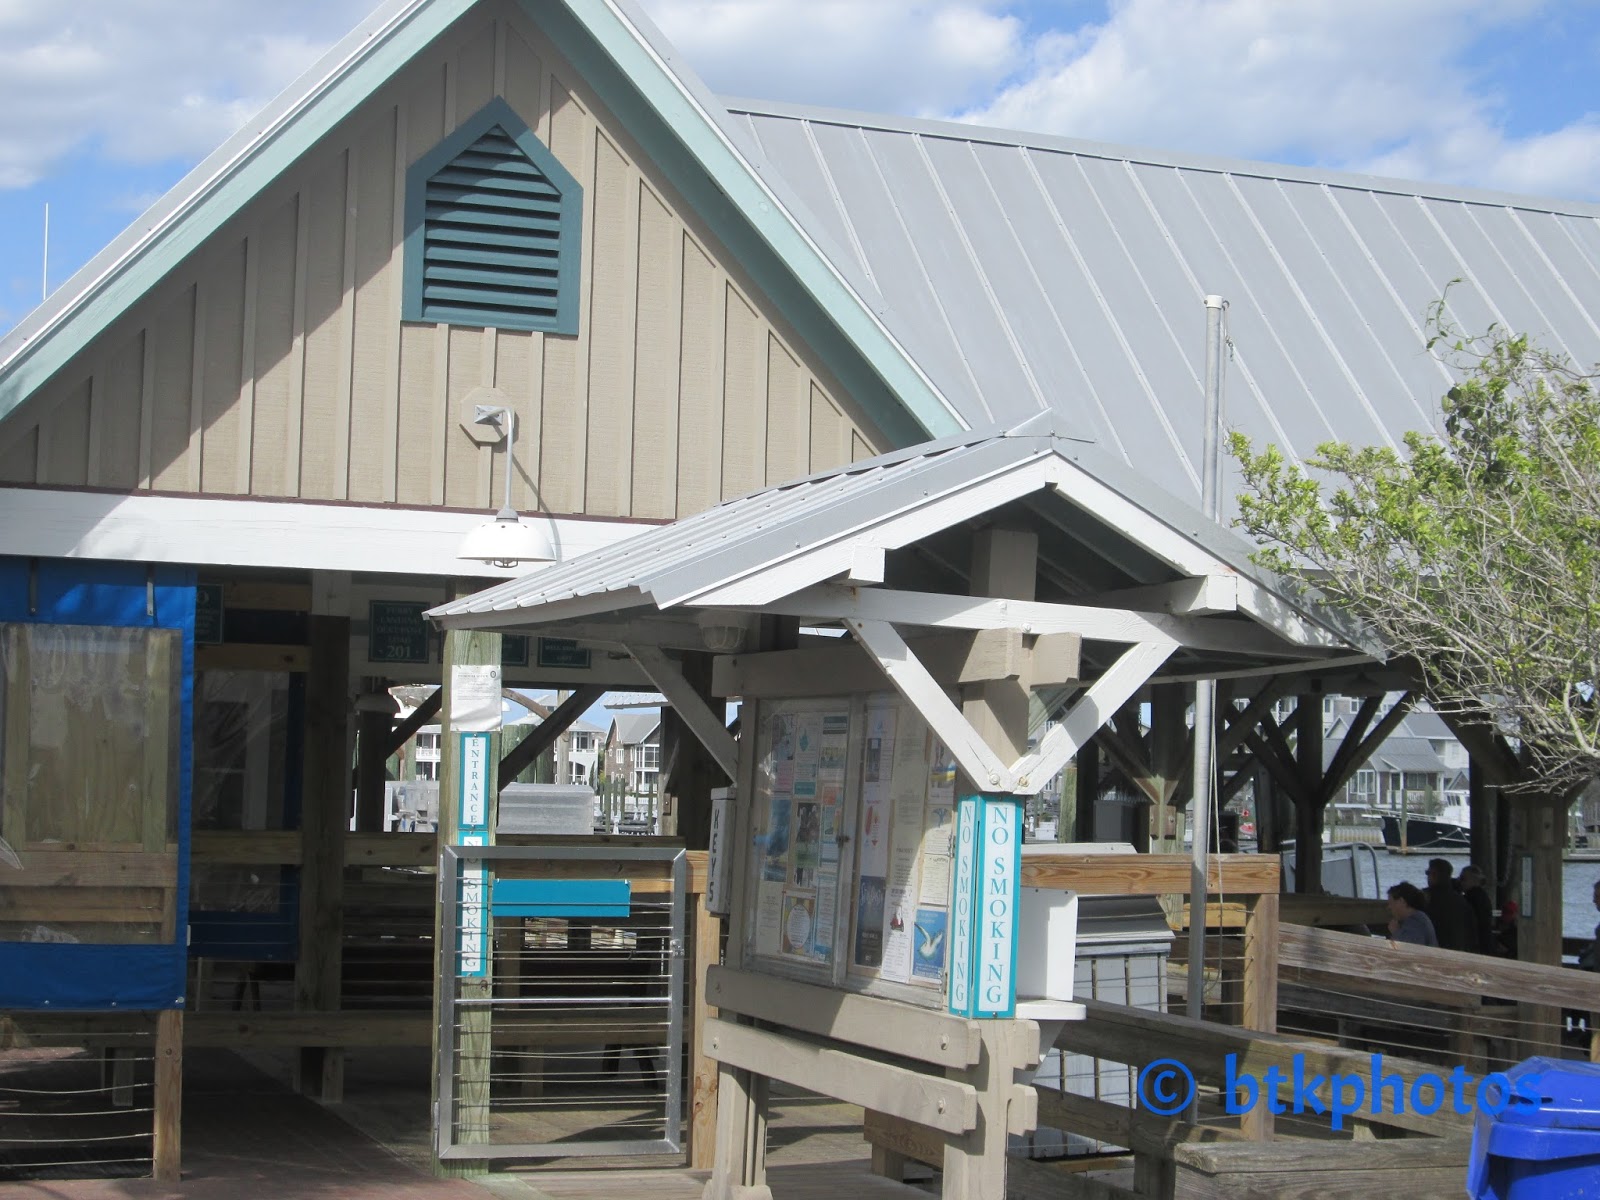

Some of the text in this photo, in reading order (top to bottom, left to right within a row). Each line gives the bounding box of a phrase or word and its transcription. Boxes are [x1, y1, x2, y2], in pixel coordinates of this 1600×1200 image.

[387, 645, 411, 658] 201
[470, 738, 480, 824] ENTRANCE
[709, 808, 720, 903] KEYS
[465, 879, 478, 968] SMOKING
[955, 805, 972, 1002] NO SMOKING
[986, 806, 1009, 1004] NO SMOKING
